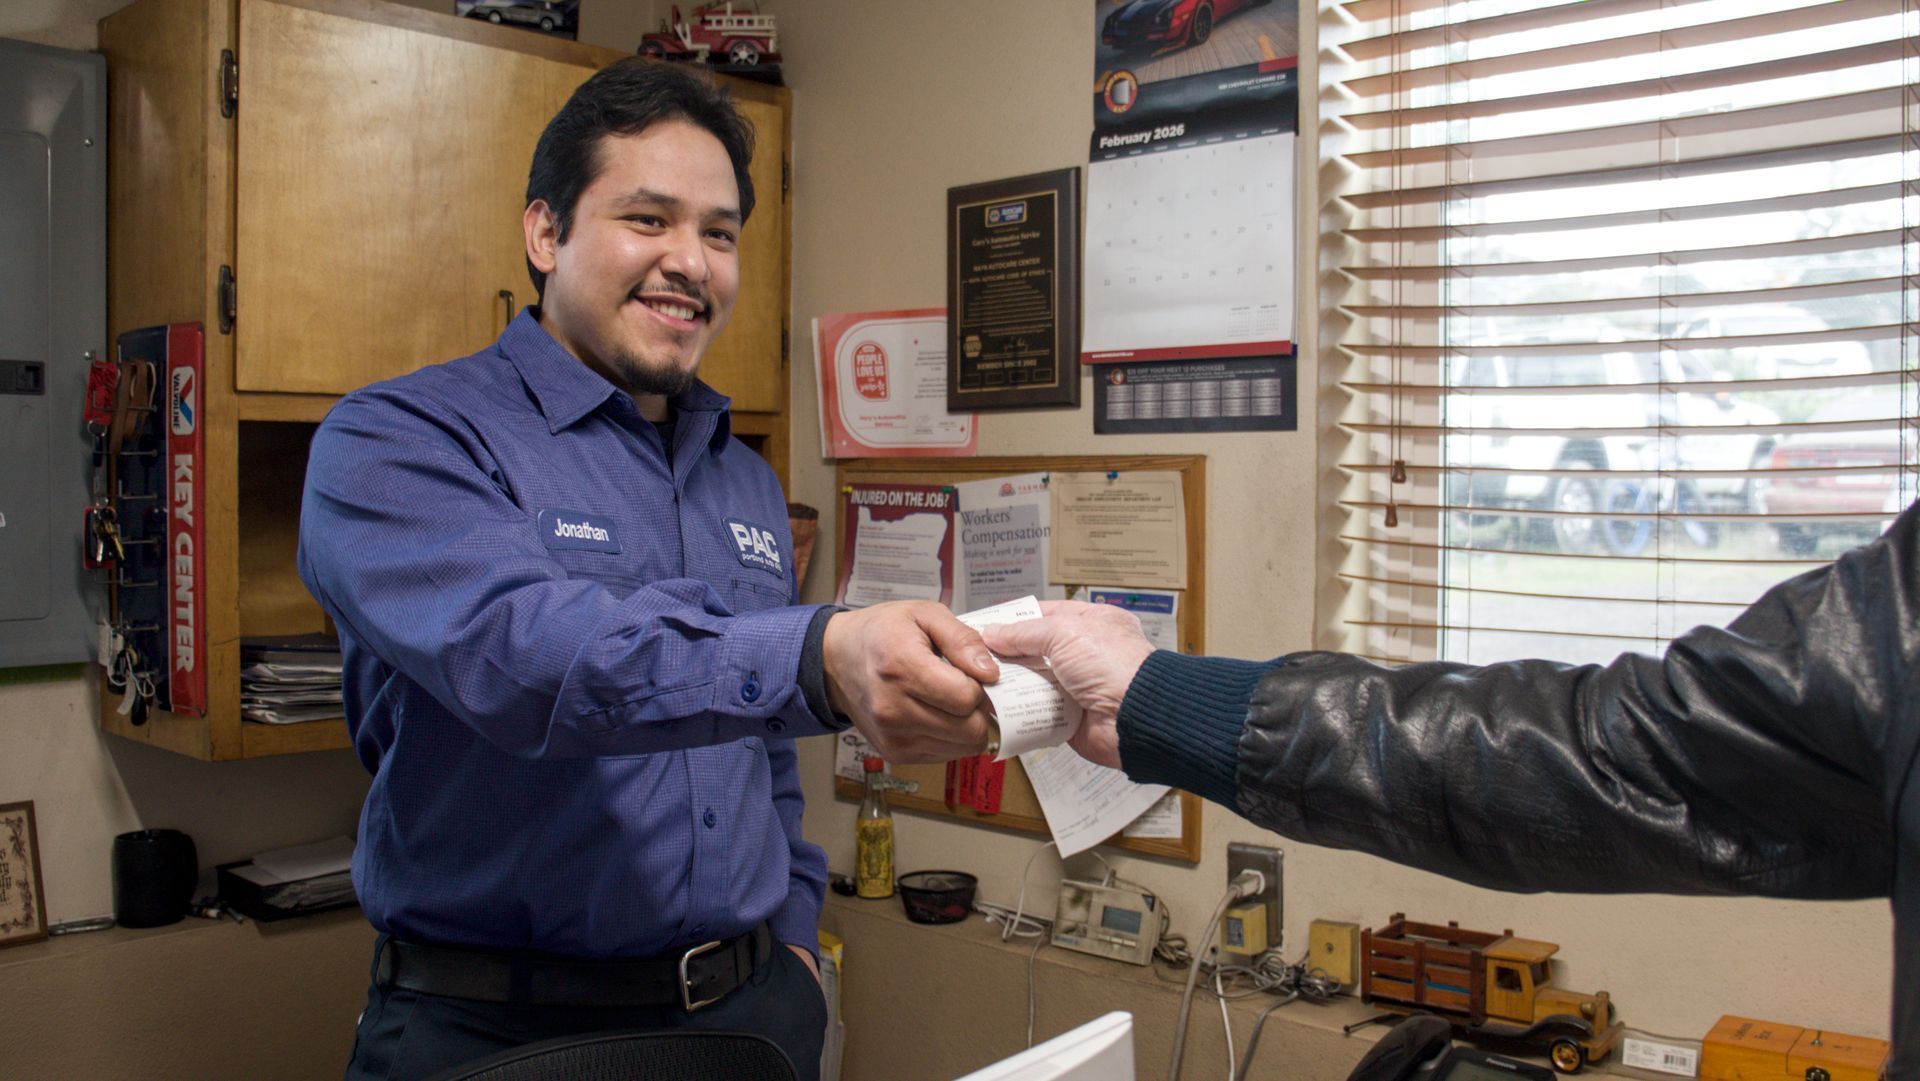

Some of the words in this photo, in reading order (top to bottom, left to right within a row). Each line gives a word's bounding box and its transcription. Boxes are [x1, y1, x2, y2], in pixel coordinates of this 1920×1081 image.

[1099, 132, 1152, 149] February
[1153, 124, 1185, 140] 2026
[1018, 257, 1041, 267] CENTER
[856, 353, 882, 365] PEOPLE
[1190, 364, 1225, 372] PURCHASES
[856, 365, 874, 377] LOVE
[874, 365, 885, 376] US
[173, 373, 181, 430] VALVOLINE
[174, 453, 193, 528] KEY
[850, 489, 887, 505] INJURED
[887, 491, 903, 506] ON
[904, 492, 925, 507] THE
[924, 493, 950, 508] JOB?
[960, 505, 1013, 526] Workers'
[554, 518, 610, 542] Jonathan
[961, 522, 1051, 547] Compensation
[729, 522, 780, 562] PAC
[995, 547, 1012, 557] work
[1012, 545, 1022, 556] for
[175, 531, 195, 673] CENTER
